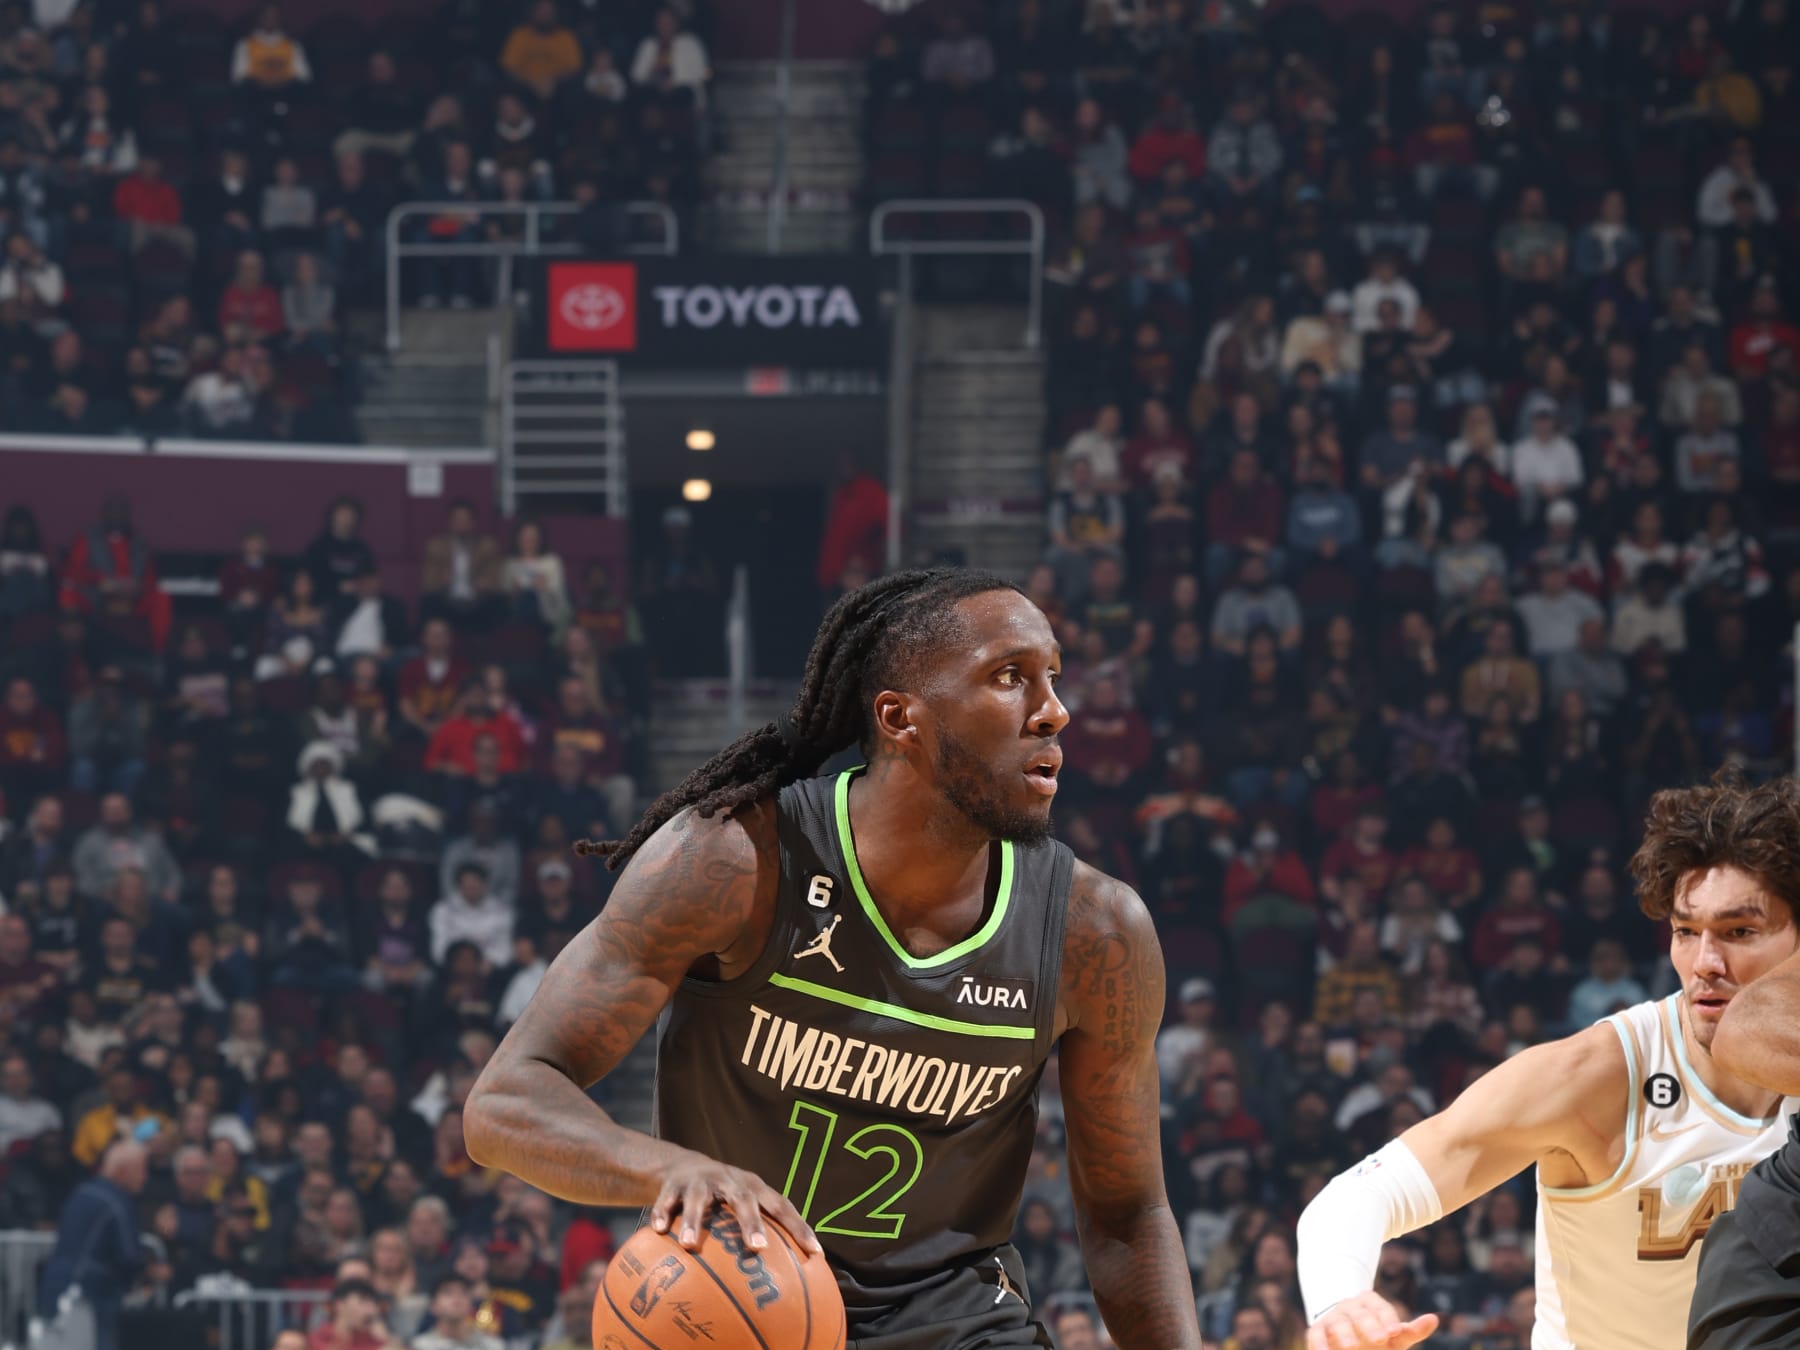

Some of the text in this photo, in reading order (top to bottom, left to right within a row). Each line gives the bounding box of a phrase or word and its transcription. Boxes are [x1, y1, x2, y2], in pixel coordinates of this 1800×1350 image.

[652, 283, 861, 328] TOYOTA
[808, 875, 834, 908] 6
[741, 1004, 1022, 1126] TIMBERWOLVES
[1652, 1077, 1672, 1105] 6
[784, 1100, 923, 1239] 12
[1637, 1178, 1743, 1261] LA
